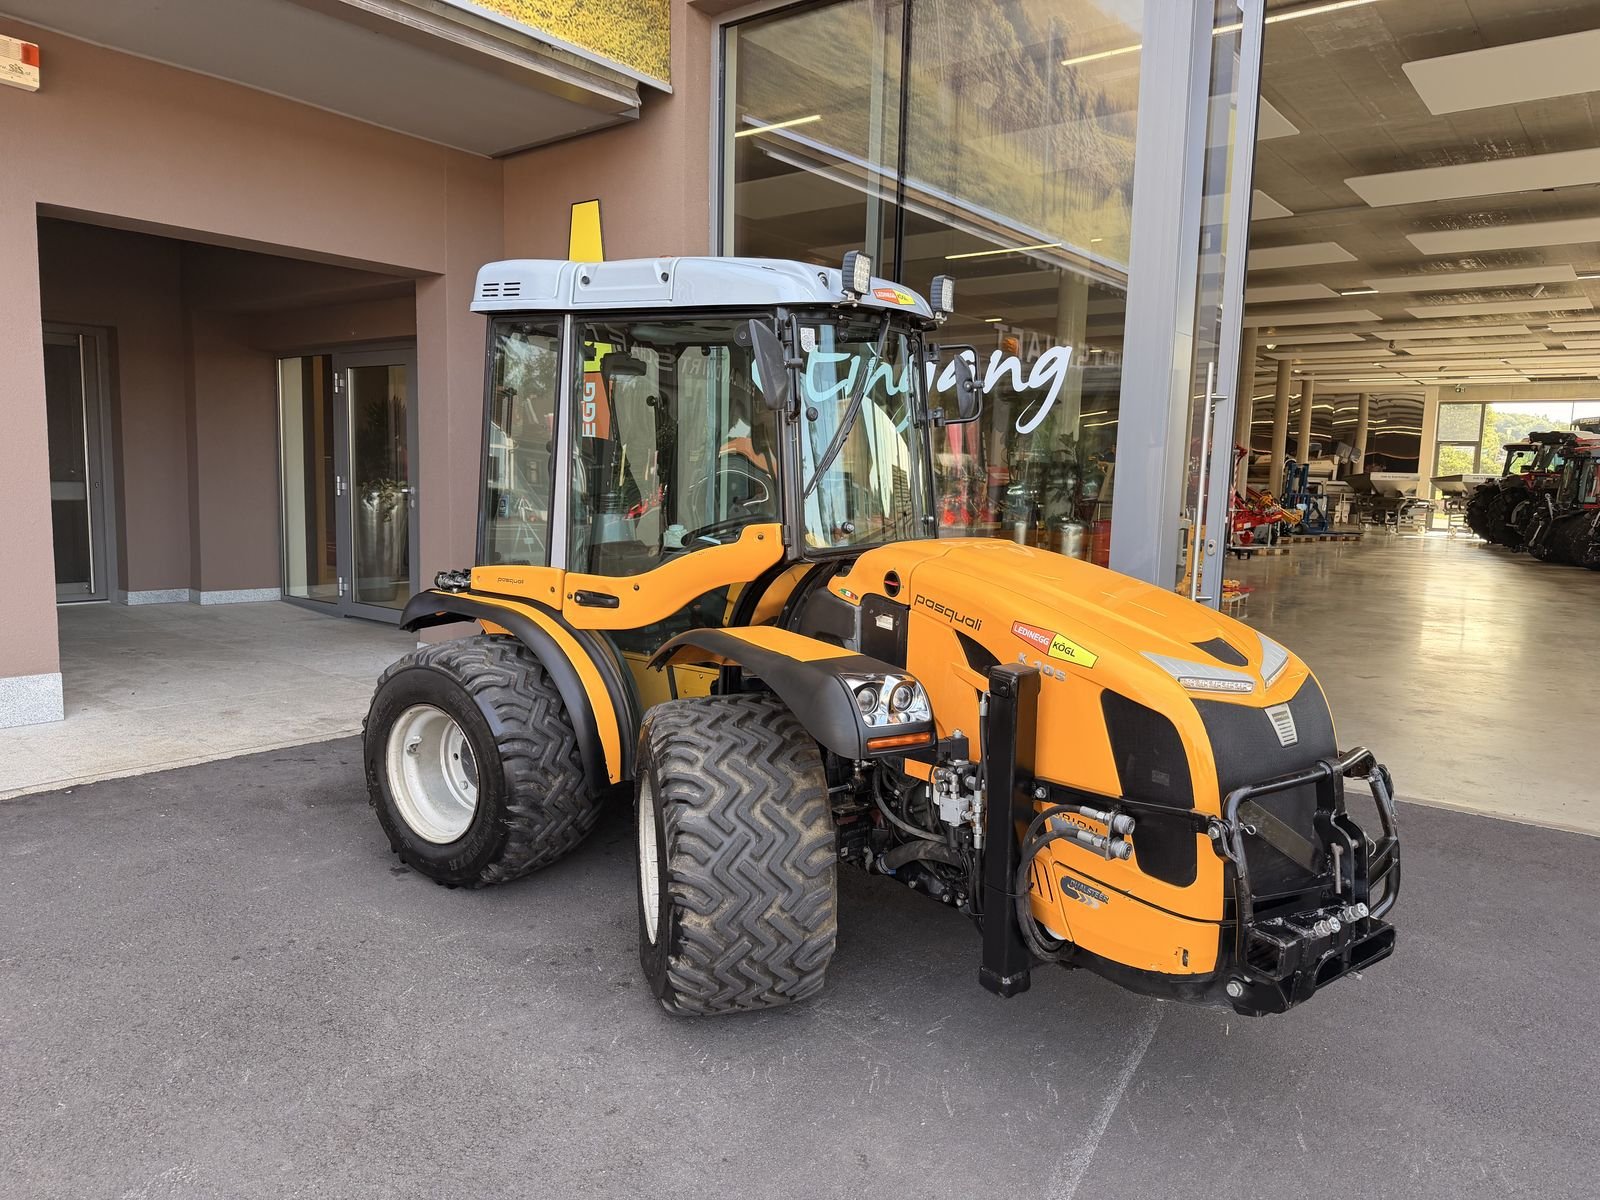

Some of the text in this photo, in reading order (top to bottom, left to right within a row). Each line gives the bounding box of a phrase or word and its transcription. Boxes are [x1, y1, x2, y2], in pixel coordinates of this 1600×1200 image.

[914, 594, 983, 631] pasquali
[1013, 624, 1076, 657] LEDINEGG KÖGL
